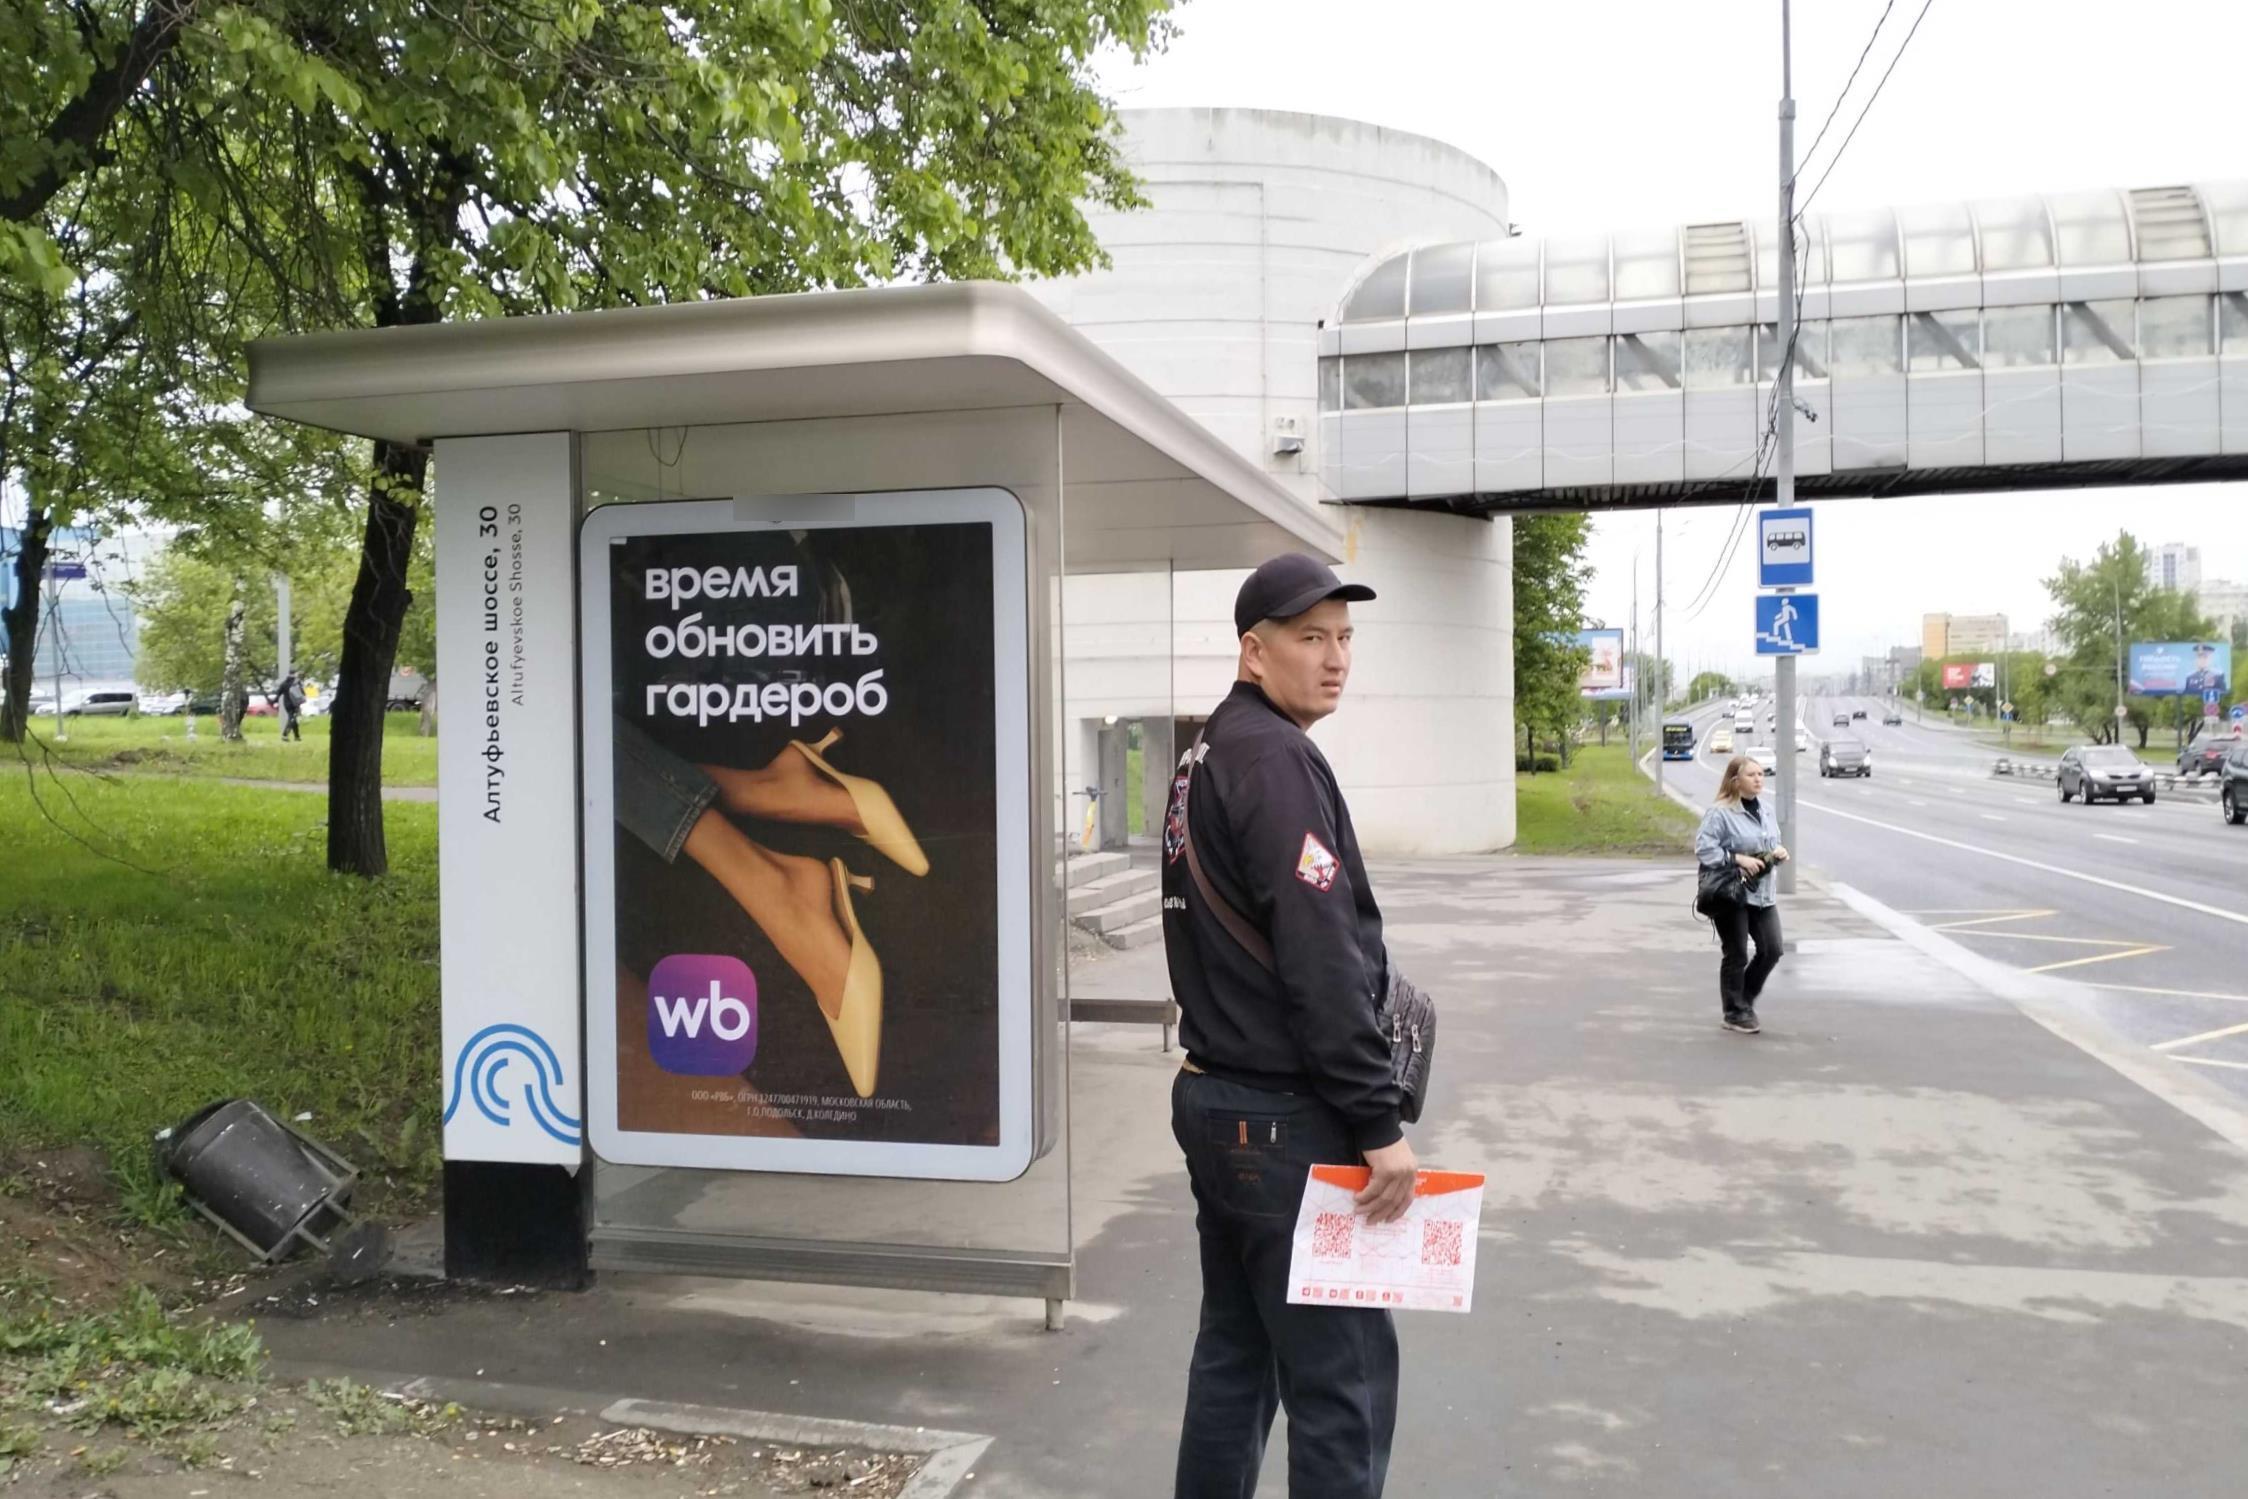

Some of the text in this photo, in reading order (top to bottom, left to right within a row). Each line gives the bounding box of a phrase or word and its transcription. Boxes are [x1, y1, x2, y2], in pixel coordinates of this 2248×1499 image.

[507, 503, 526, 706] Altufyevskoe Shosse, 30
[645, 565, 798, 609] время
[645, 613, 878, 658] обновить
[479, 506, 505, 823] Алтуфьевское шоссе, 30
[645, 669, 887, 726] гардероб
[654, 980, 750, 1041] wb
[691, 1090, 709, 1100] ООО
[821, 1096, 873, 1108] МОСКОВСКАЯ
